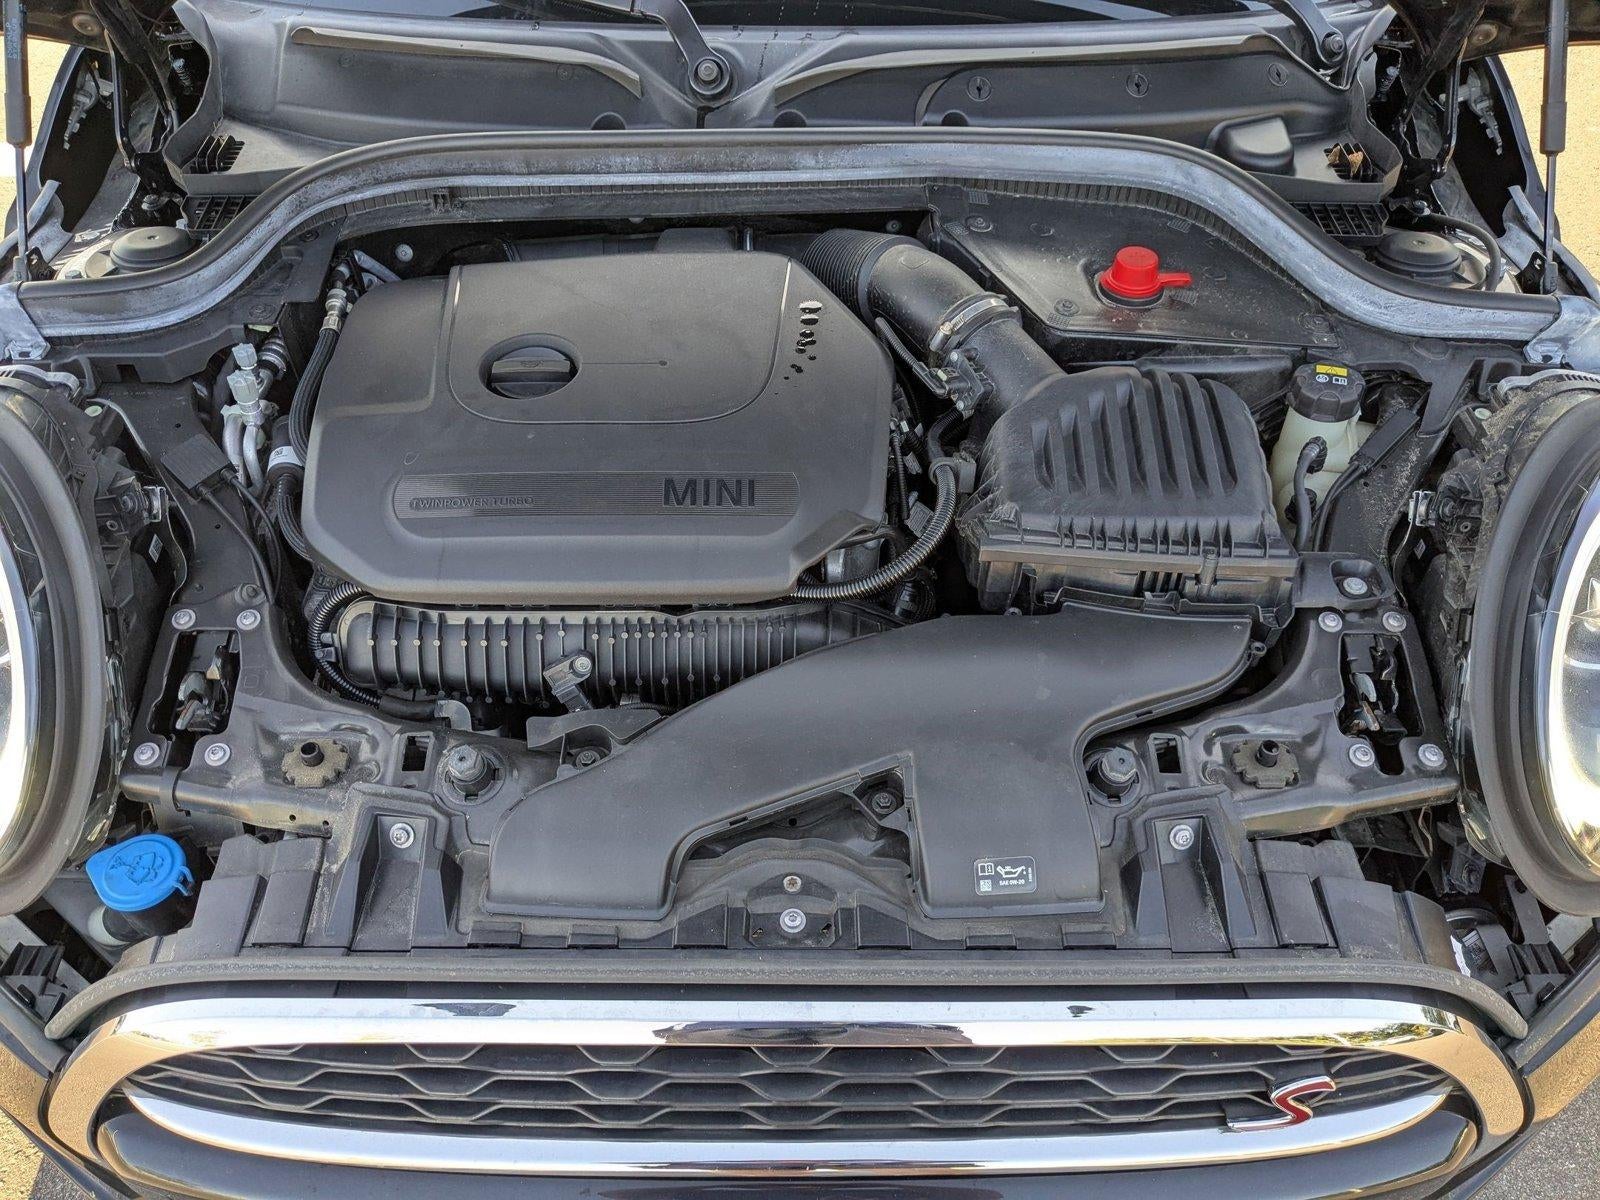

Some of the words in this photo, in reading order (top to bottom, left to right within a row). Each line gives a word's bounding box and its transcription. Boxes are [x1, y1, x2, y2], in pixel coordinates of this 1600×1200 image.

[411, 497, 489, 509] TWINPOWER
[492, 496, 534, 508] TURBO
[663, 478, 755, 507] MINI
[1226, 1075, 1336, 1131] S
